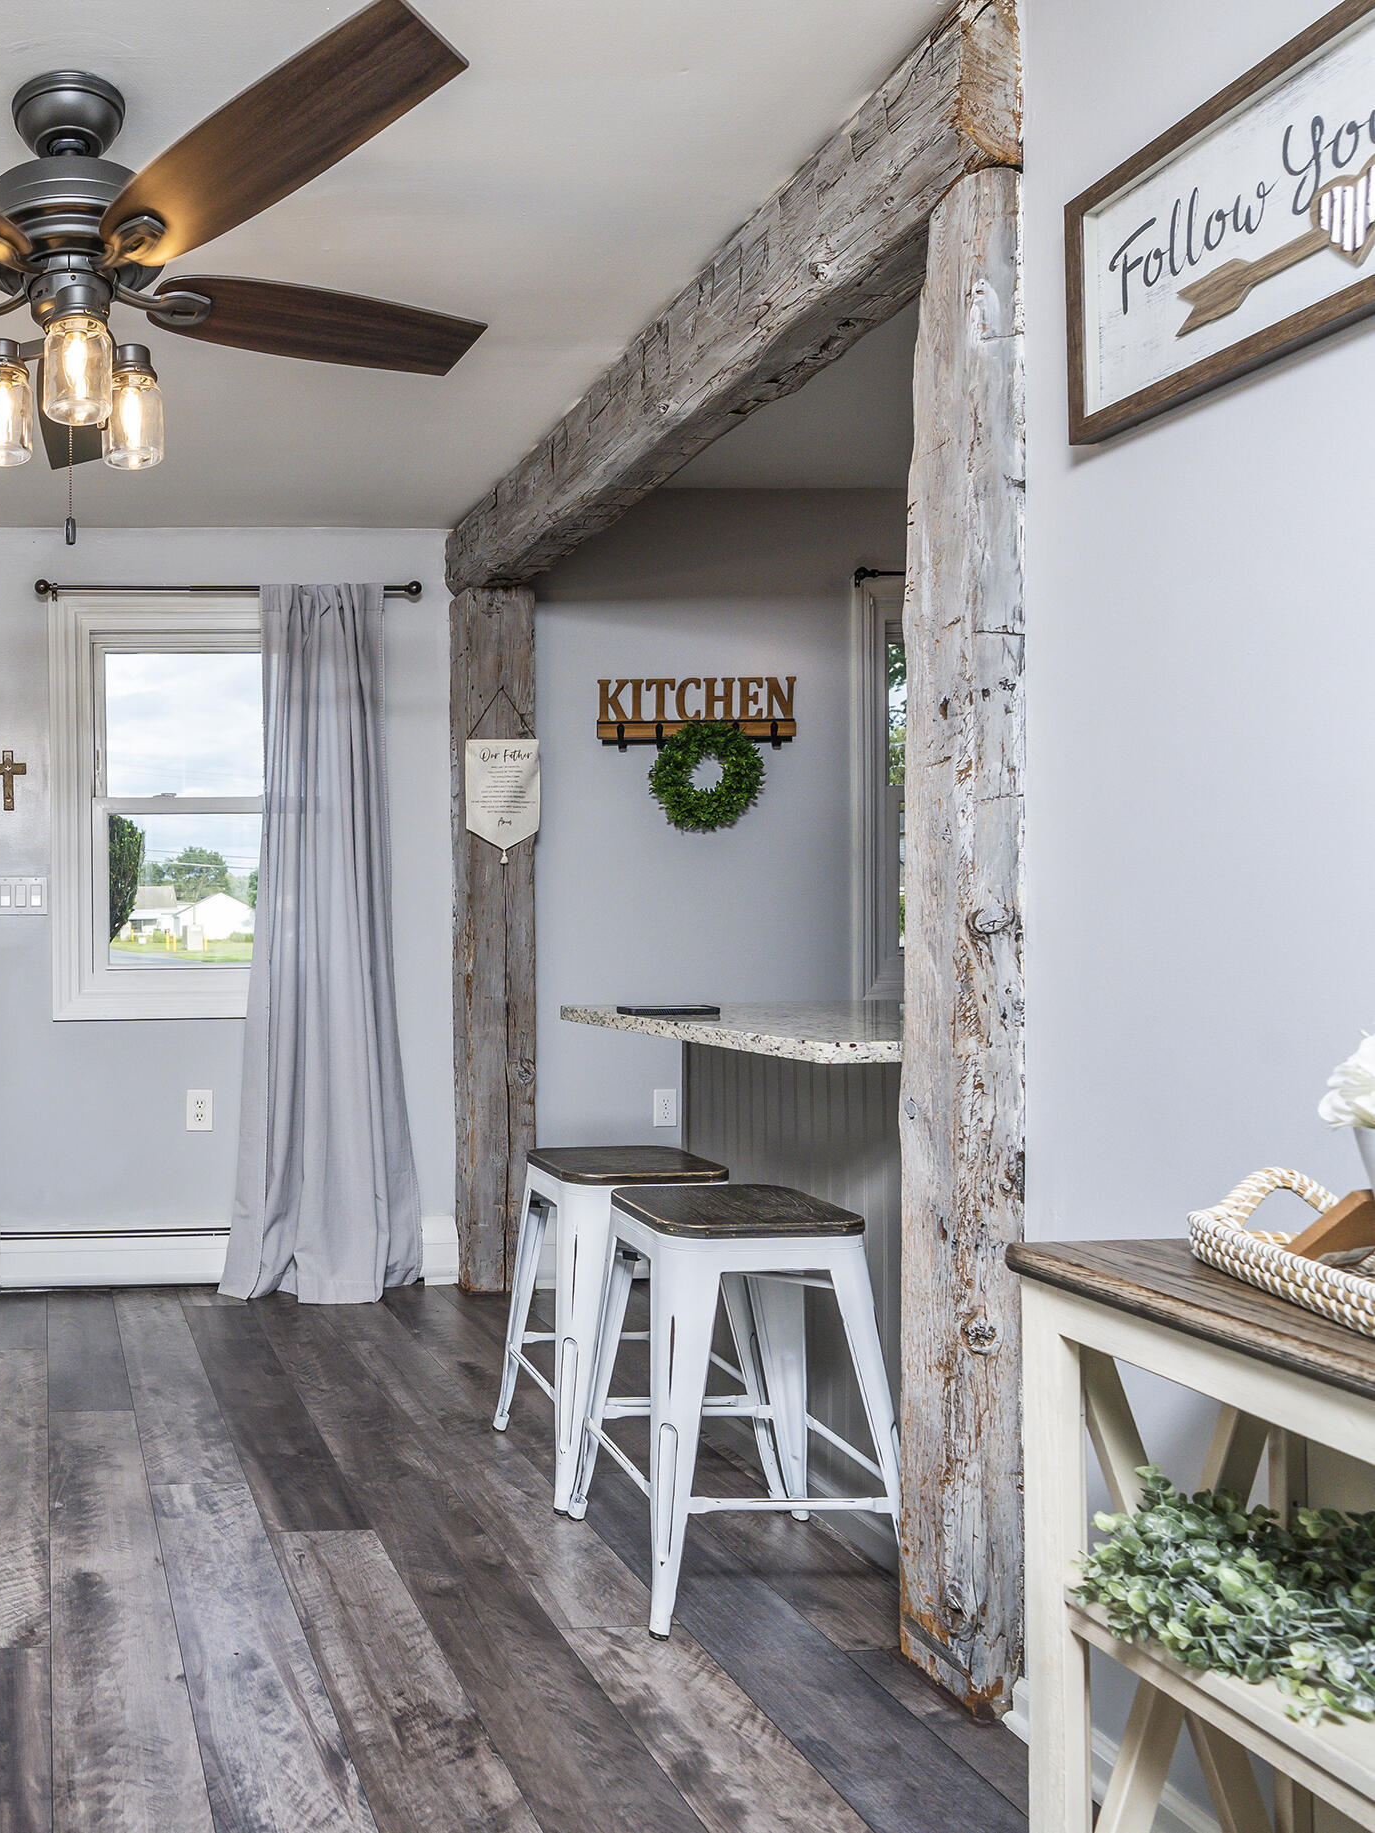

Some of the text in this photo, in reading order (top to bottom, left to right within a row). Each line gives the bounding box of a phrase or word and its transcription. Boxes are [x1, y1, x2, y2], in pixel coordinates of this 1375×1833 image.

[1109, 109, 1375, 315] Follow Yo
[596, 676, 797, 721] KITCHEN
[480, 747, 533, 763] Our Father
